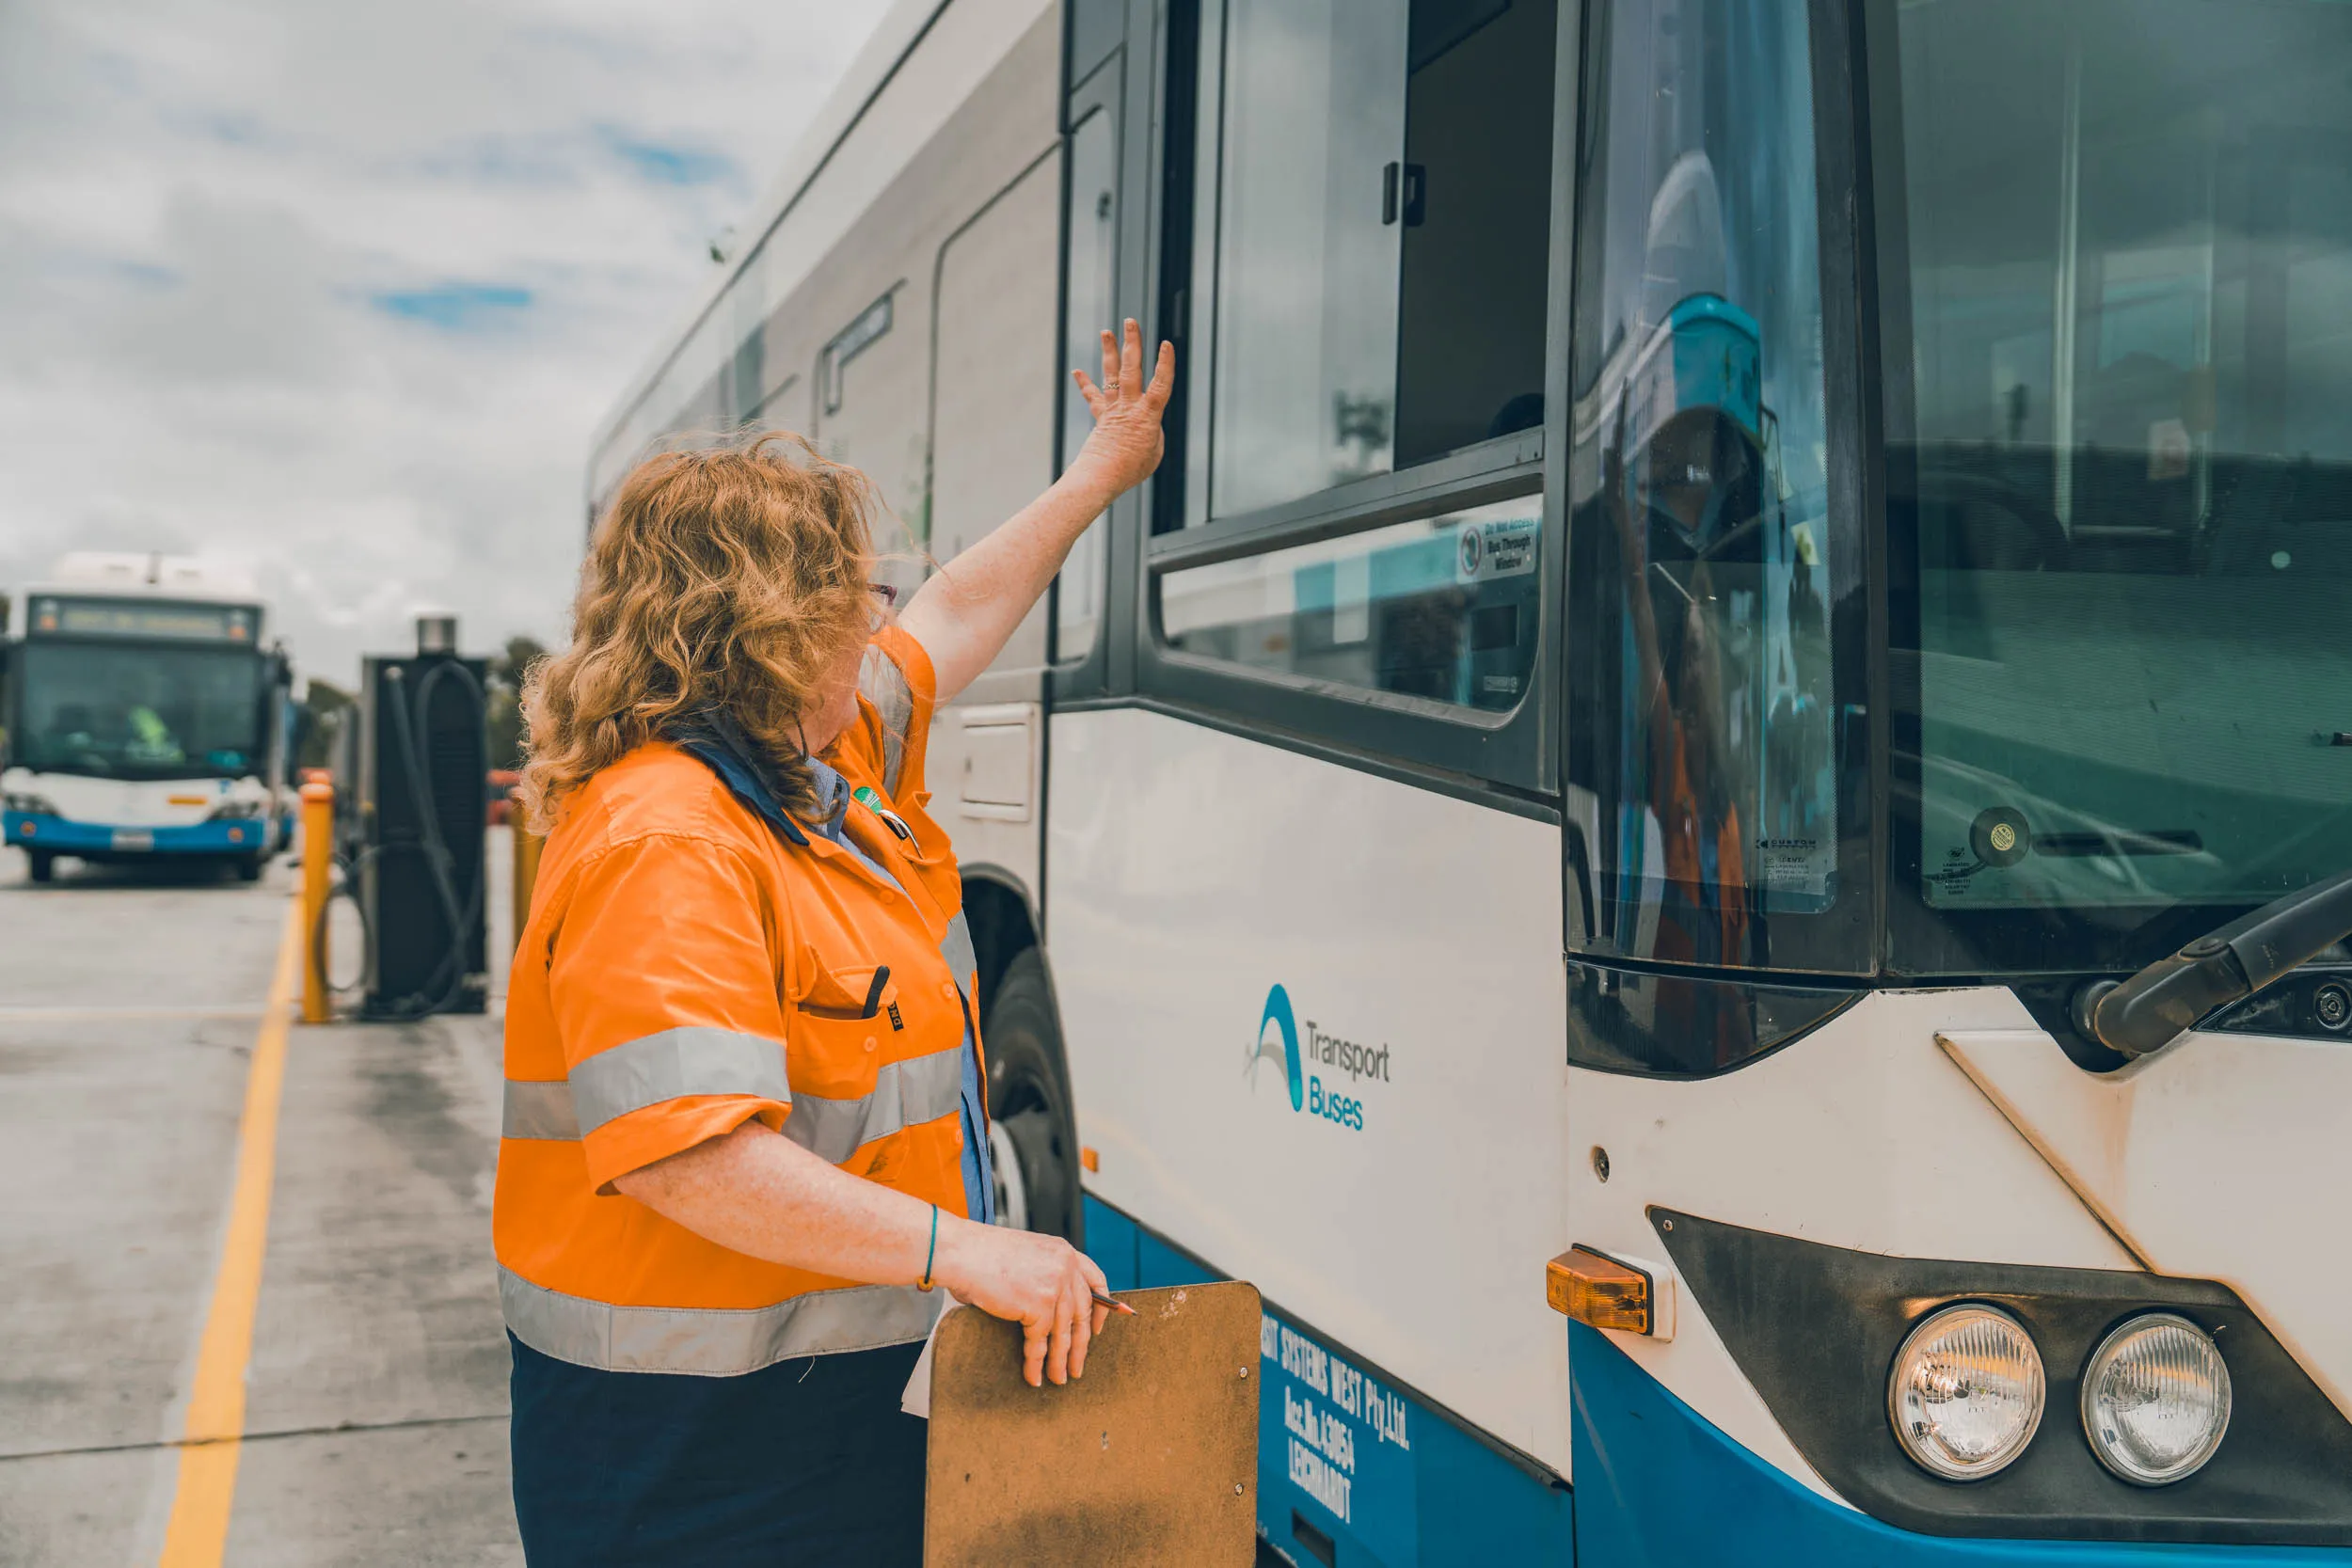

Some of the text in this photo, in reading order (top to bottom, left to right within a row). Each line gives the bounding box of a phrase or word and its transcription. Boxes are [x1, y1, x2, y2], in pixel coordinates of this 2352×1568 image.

[1487, 534, 1531, 554] Bus Through
[1306, 1020, 1390, 1083] Transport
[1310, 1075, 1363, 1131] Buses
[1261, 1314, 1279, 1362] SIT
[1281, 1325, 1327, 1397] SYSTEMS
[1330, 1356, 1361, 1418] WEST
